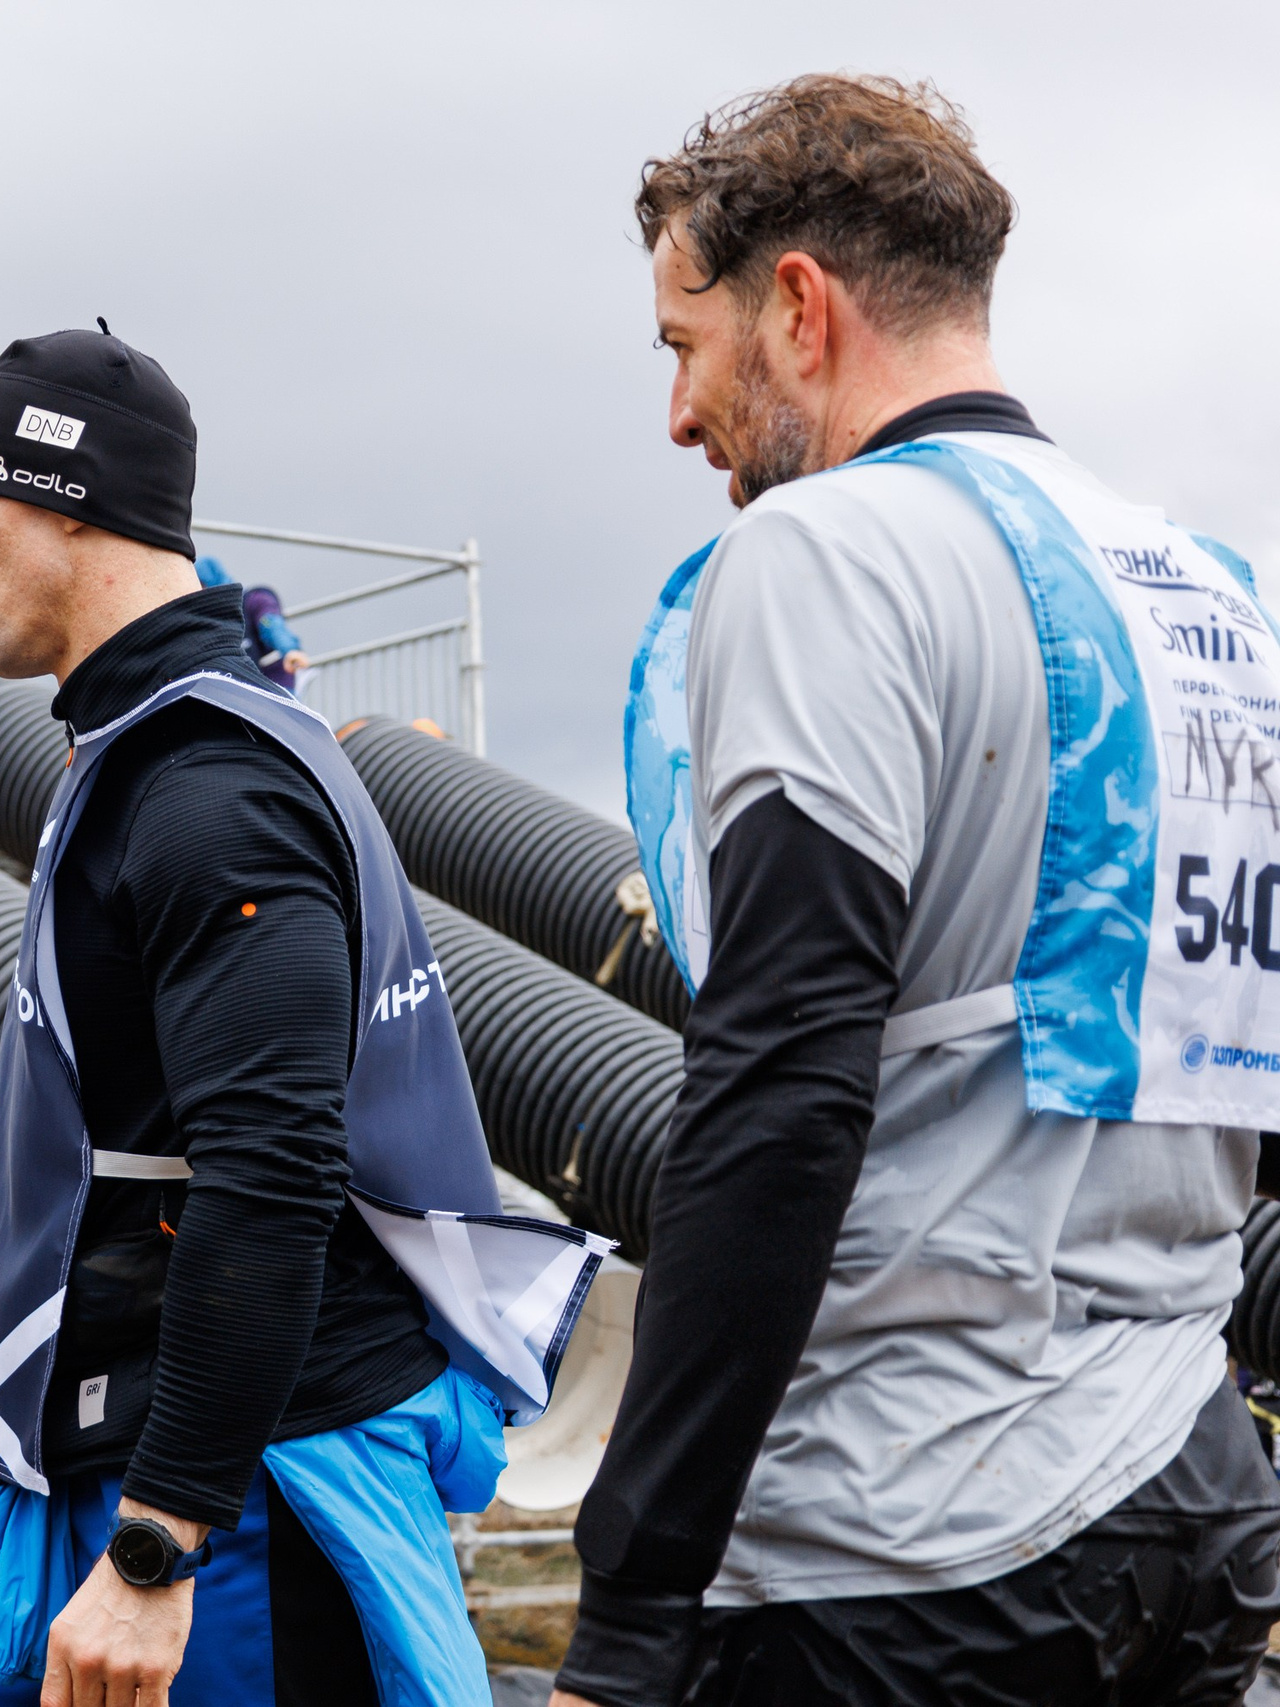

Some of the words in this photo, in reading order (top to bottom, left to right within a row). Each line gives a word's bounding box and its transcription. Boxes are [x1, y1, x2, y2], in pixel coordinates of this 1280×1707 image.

[25, 413, 74, 443] DNB
[12, 468, 87, 501] odlo
[1150, 605, 1268, 667] Smin
